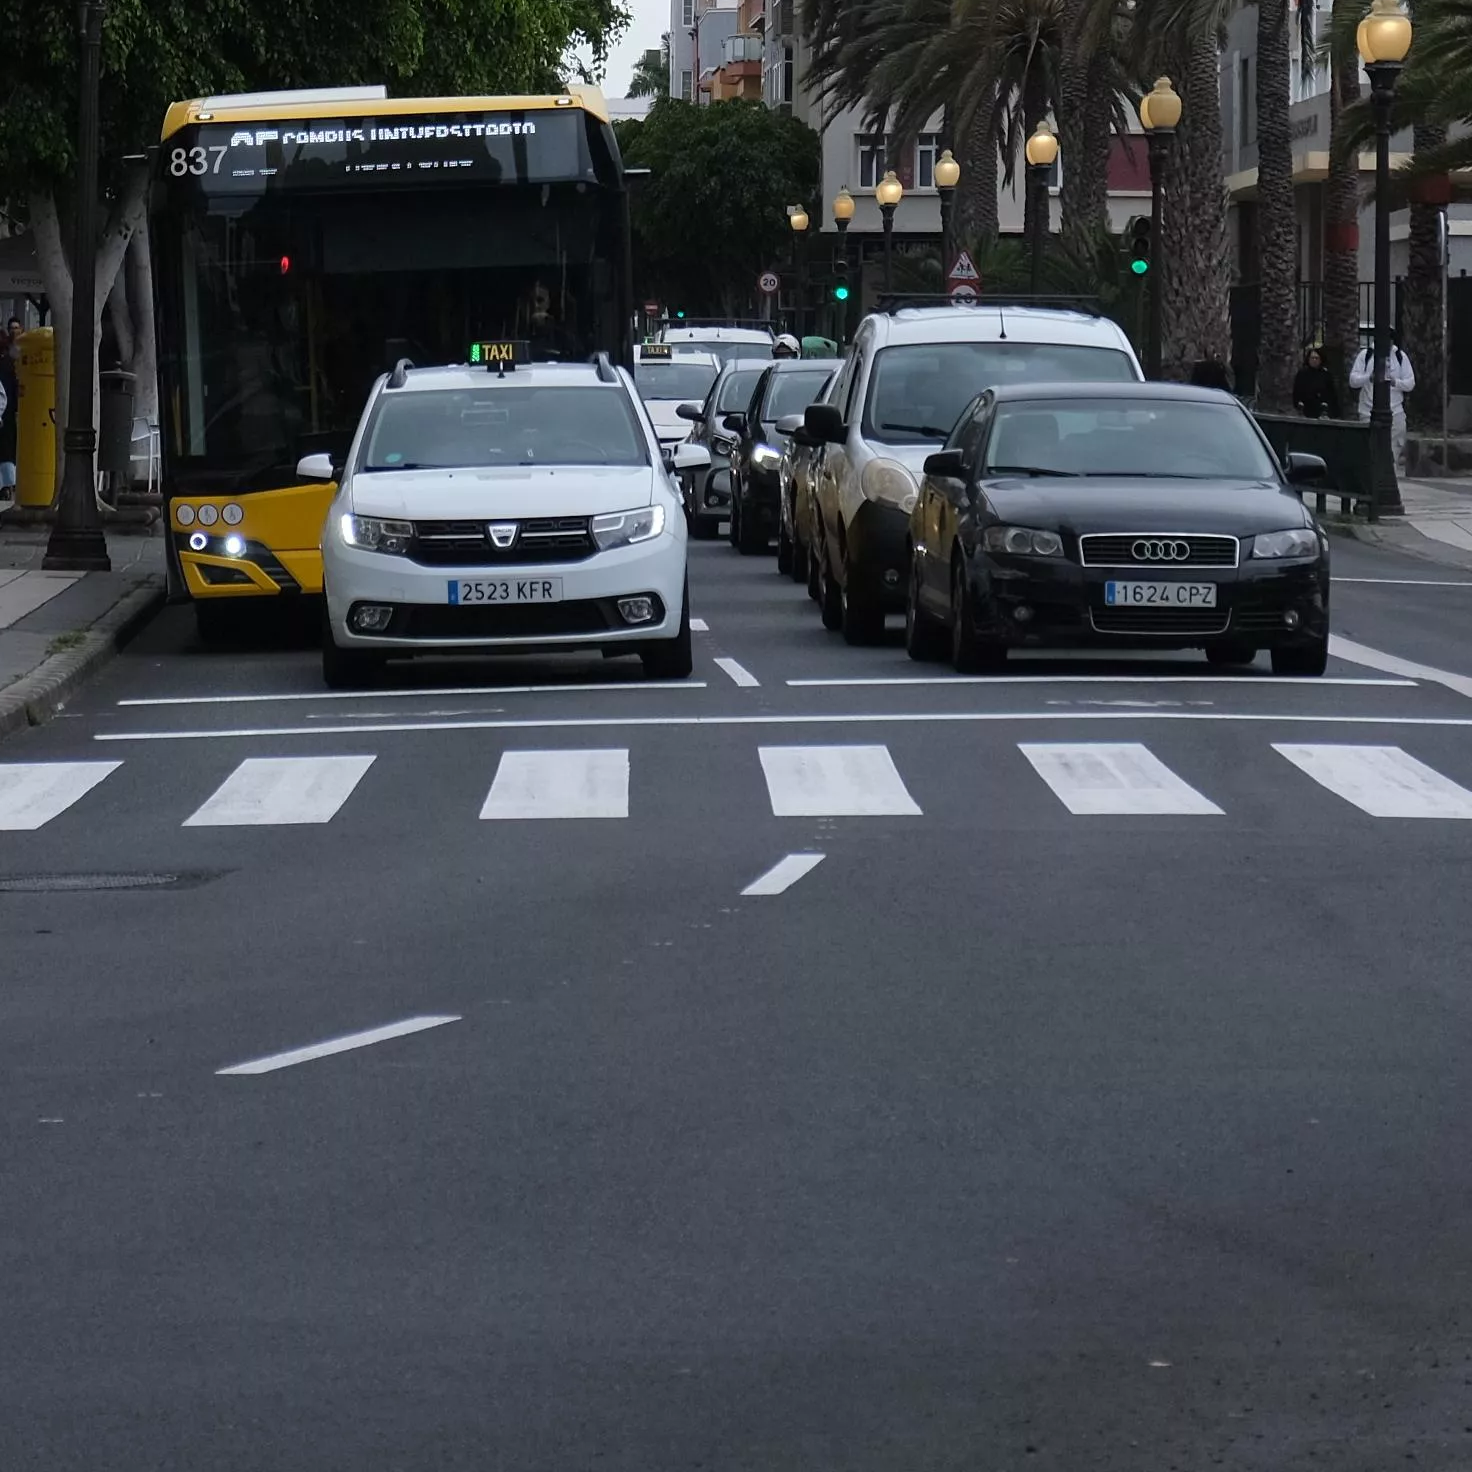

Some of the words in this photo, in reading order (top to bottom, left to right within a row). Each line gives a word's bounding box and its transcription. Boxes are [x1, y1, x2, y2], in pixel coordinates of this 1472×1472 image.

[170, 145, 228, 177] 837
[763, 278, 776, 287] 20
[482, 343, 513, 361] TAXI
[462, 582, 510, 601] 2523
[517, 581, 553, 600] KFR
[1122, 585, 1170, 603] 1624
[1176, 586, 1213, 605] CPZ
